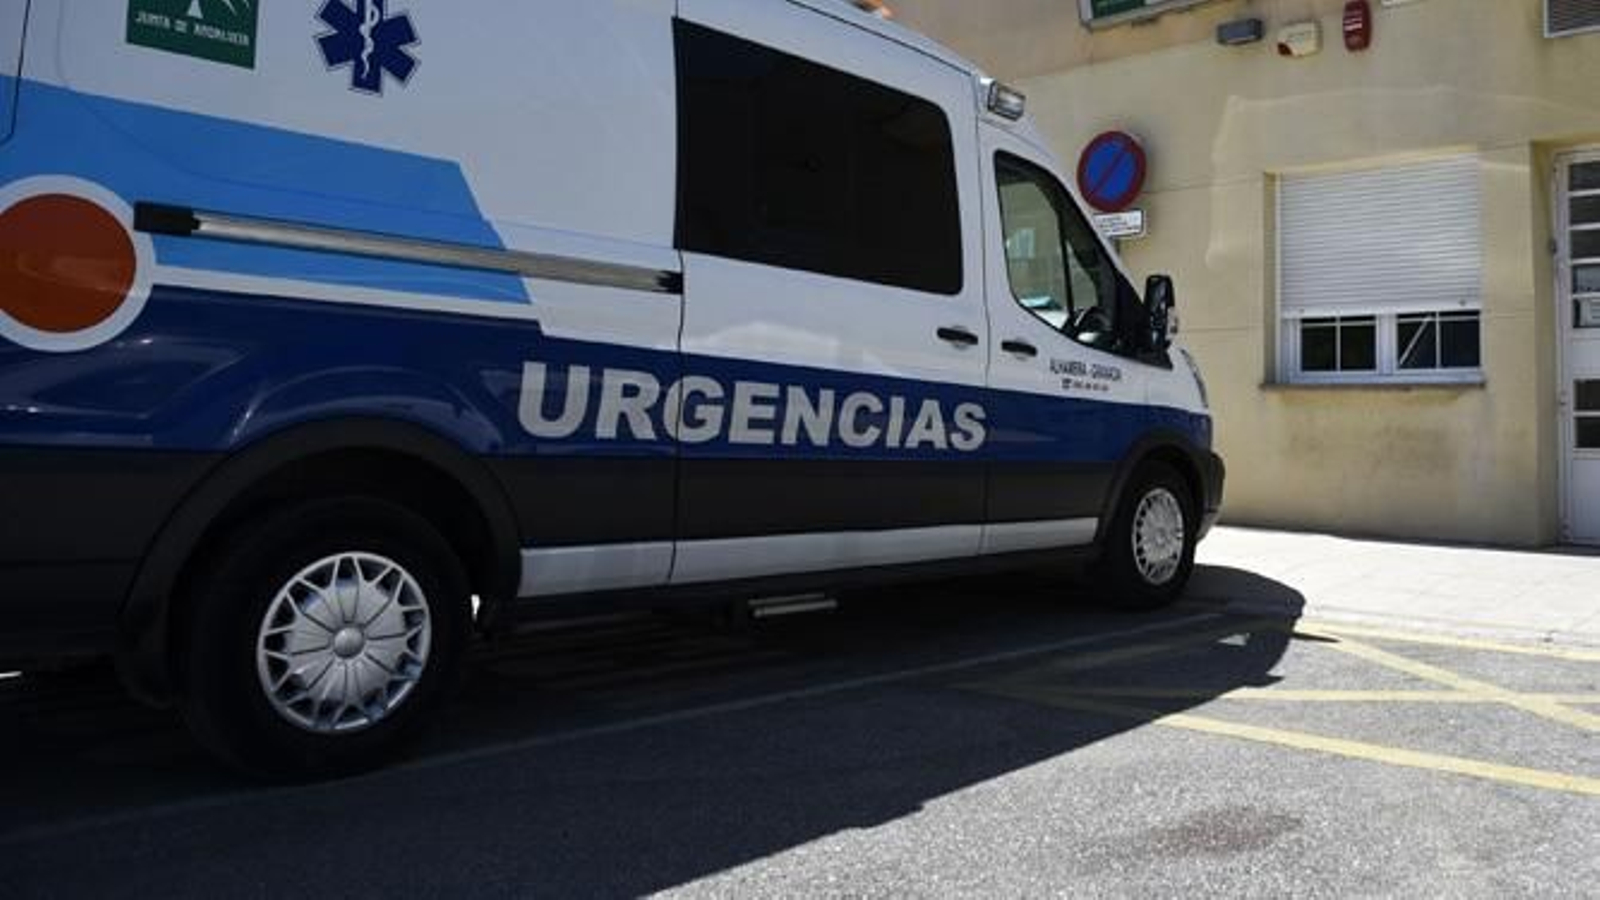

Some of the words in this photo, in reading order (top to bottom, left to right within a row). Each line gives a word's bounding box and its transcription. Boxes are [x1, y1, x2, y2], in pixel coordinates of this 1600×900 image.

[135, 11, 171, 29] JUNTA
[174, 19, 187, 33] DE
[517, 360, 987, 452] URGENCIAS
